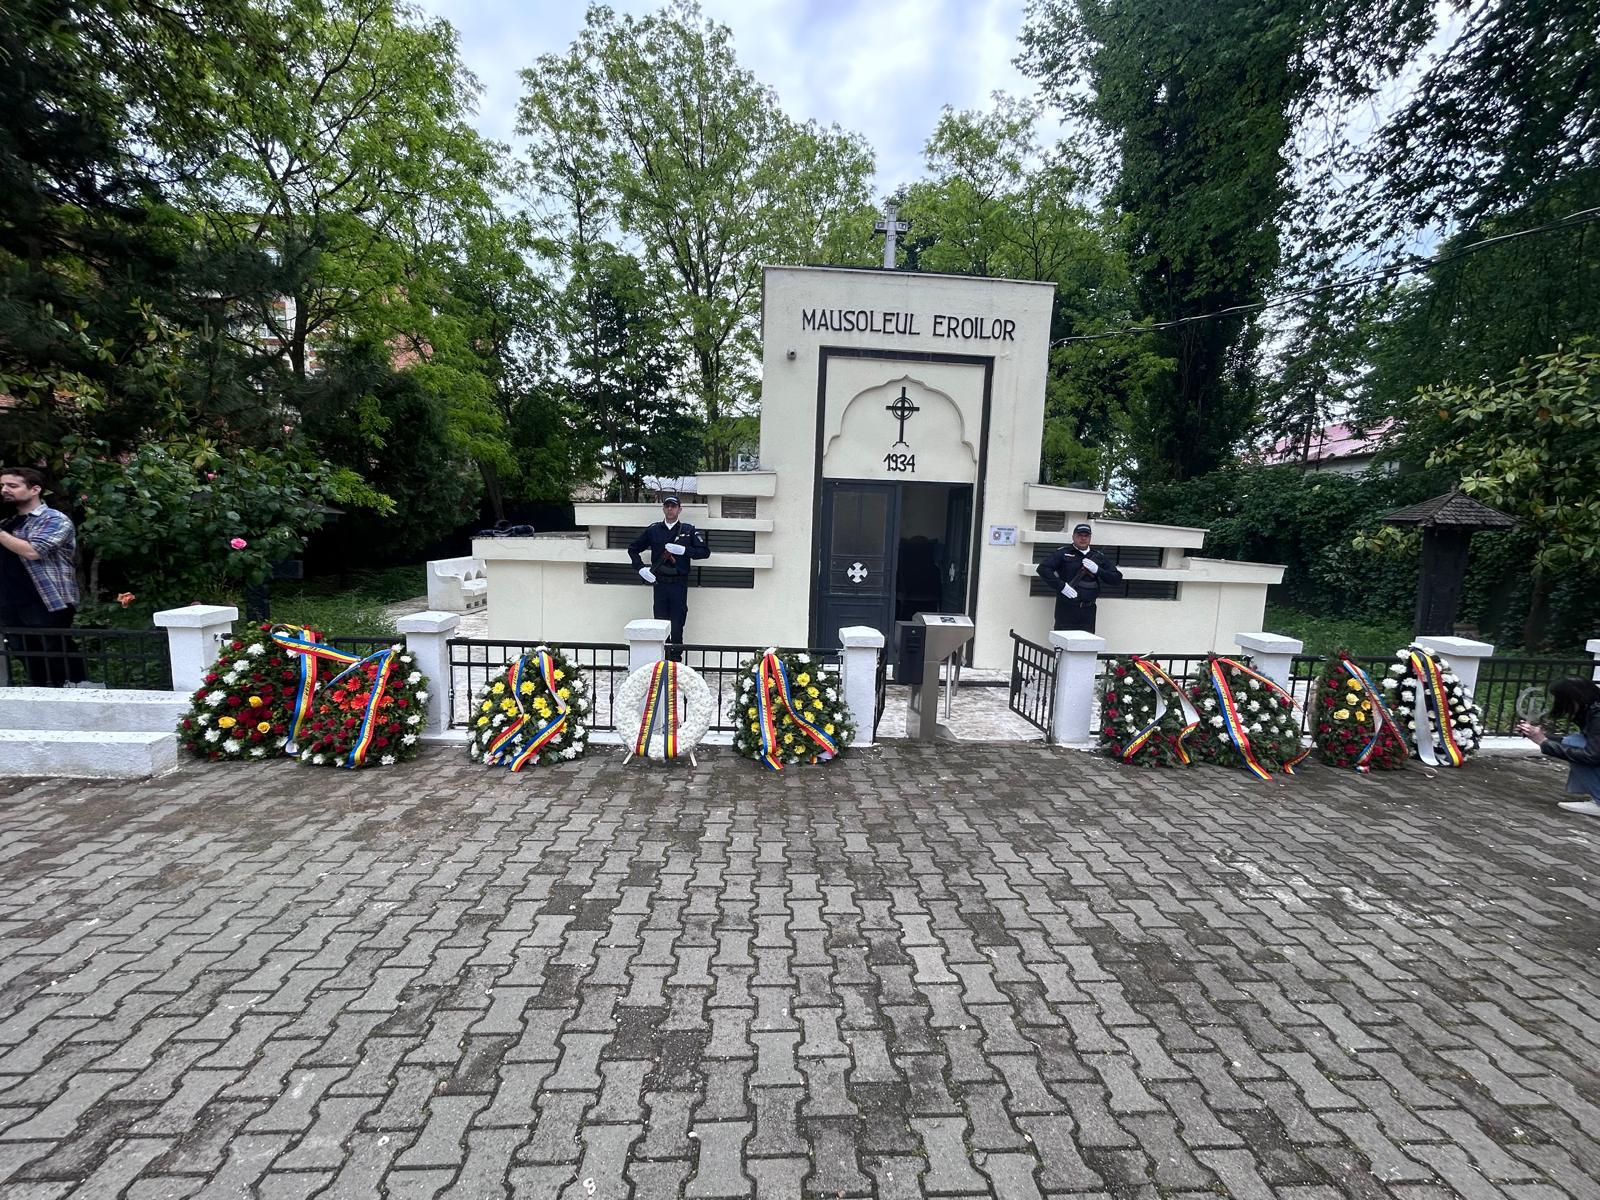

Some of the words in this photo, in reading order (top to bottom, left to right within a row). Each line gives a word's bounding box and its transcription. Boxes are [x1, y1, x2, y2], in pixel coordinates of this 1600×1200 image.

[802, 309, 920, 335] MAUSOLEUL
[933, 314, 1016, 341] EROILOR
[883, 453, 915, 472] 1934
